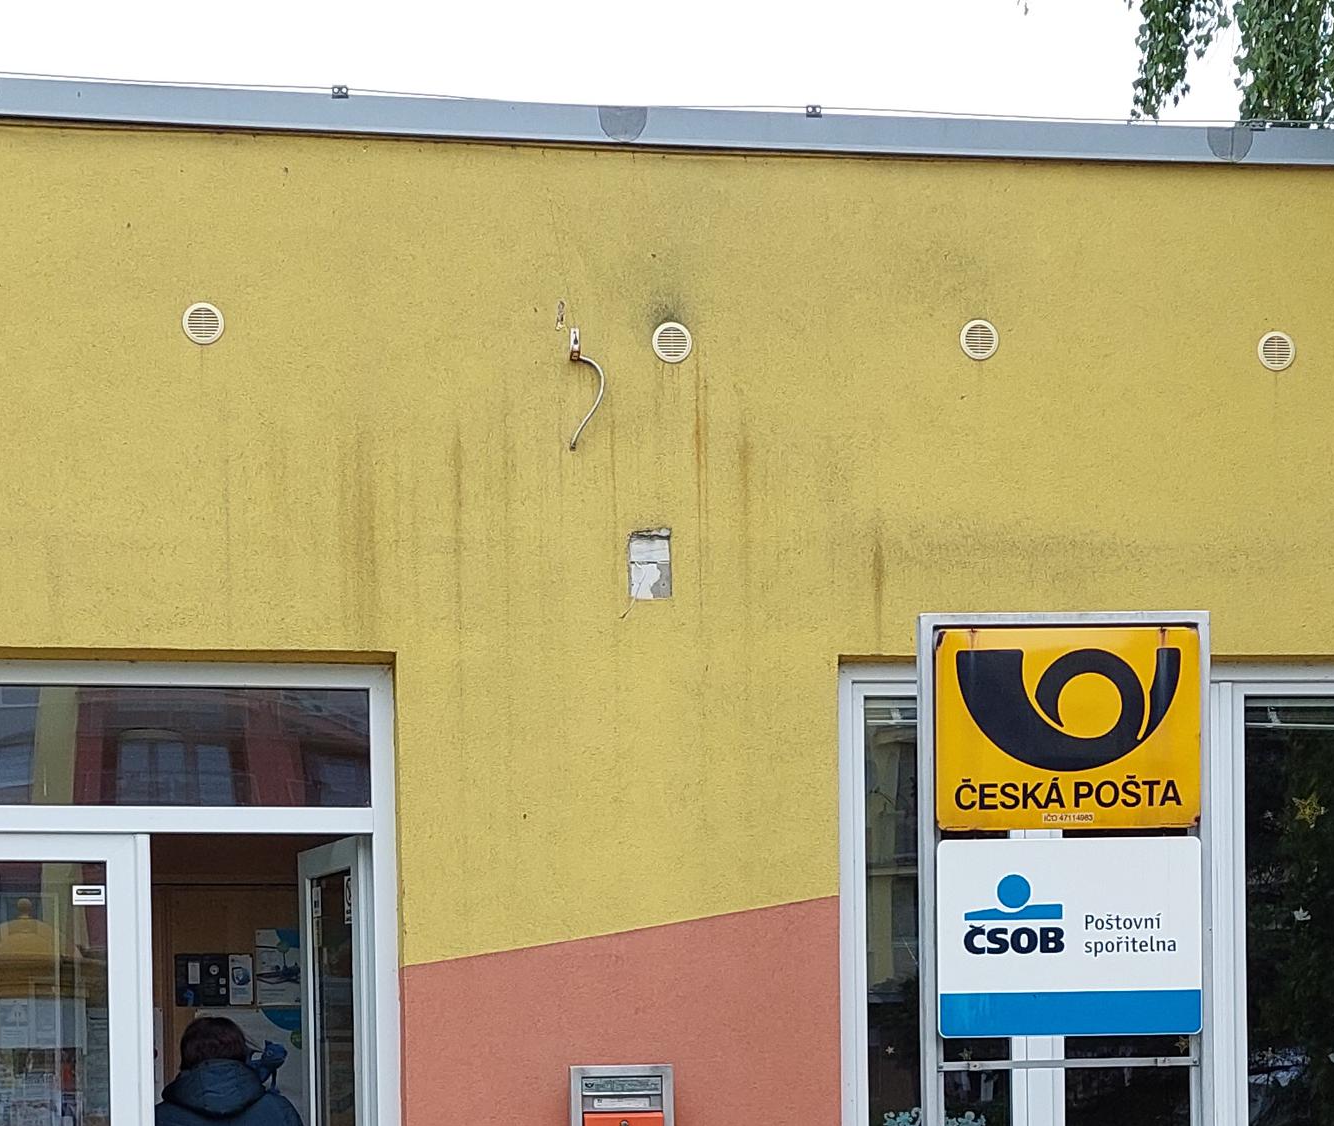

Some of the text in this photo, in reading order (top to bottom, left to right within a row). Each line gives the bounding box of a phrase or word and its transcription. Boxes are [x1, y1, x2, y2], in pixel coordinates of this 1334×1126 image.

[955, 775, 1182, 810] ČESKÁ POŠTA
[1084, 913, 1162, 930] Poštovní
[964, 924, 1065, 955] ČSOB
[1084, 936, 1177, 957] spořitelna
